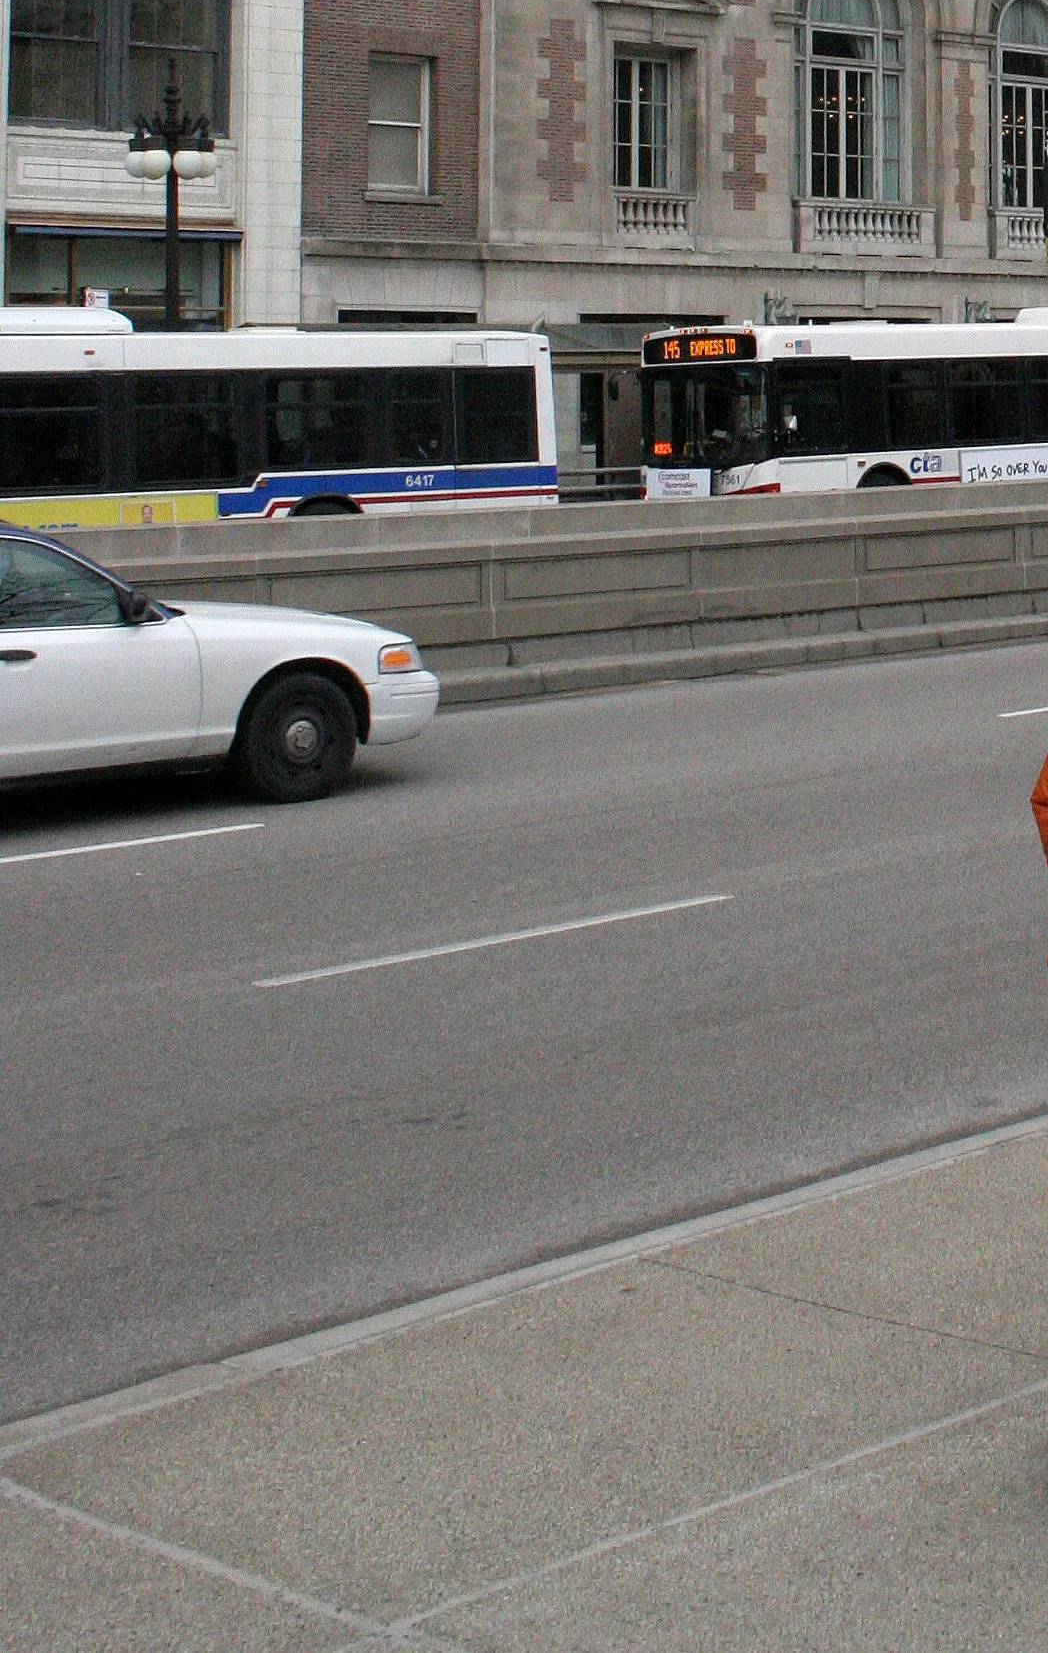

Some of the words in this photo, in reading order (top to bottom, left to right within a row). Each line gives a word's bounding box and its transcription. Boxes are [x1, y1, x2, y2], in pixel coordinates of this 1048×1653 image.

[663, 340, 680, 359] 145
[690, 338, 724, 357] EXPRESS
[725, 338, 736, 355] TO
[910, 452, 942, 473] cta
[991, 465, 1003, 480] SO
[1006, 463, 1030, 477] OVER
[405, 474, 435, 487] 6417
